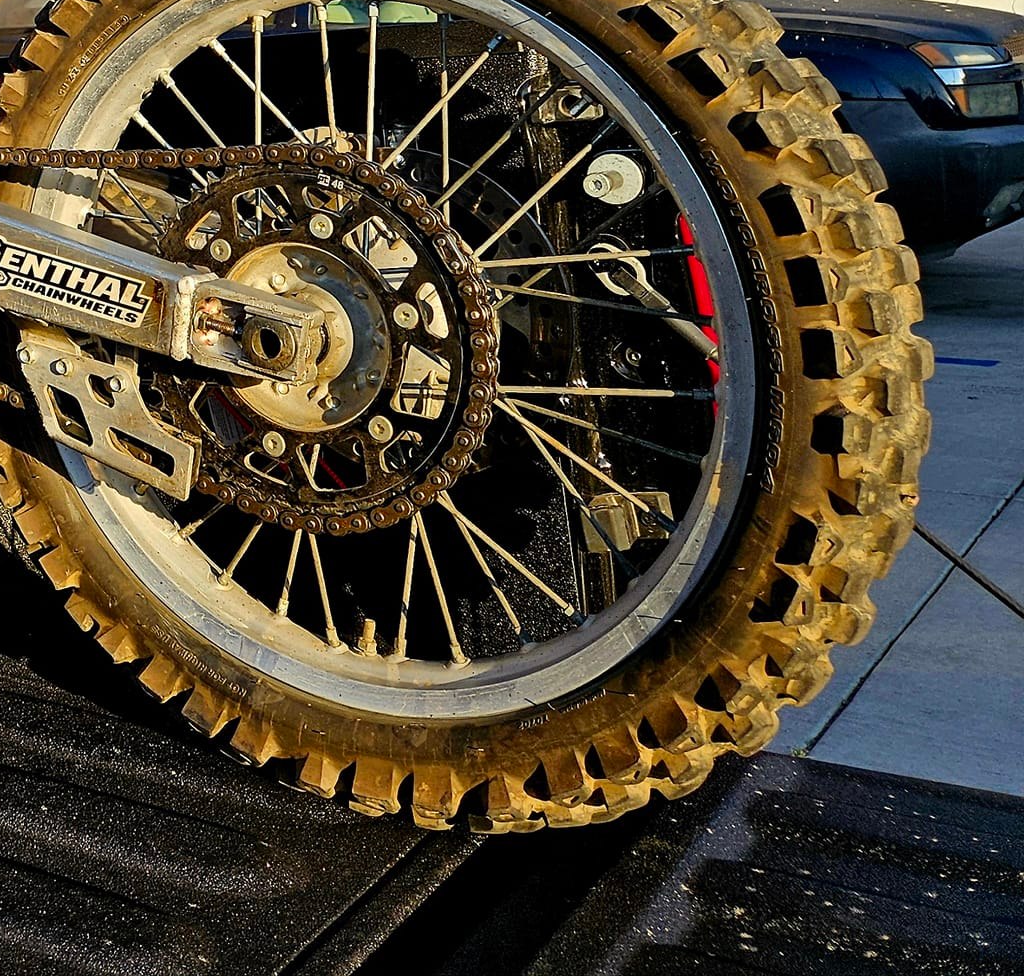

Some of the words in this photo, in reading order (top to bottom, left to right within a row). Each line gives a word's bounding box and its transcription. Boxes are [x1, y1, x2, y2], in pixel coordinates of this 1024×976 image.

[331, 179, 344, 190] 48
[11, 277, 139, 324] CHAINWHEELS
[208, 669, 227, 684] FOR
[229, 682, 247, 697] NOT
